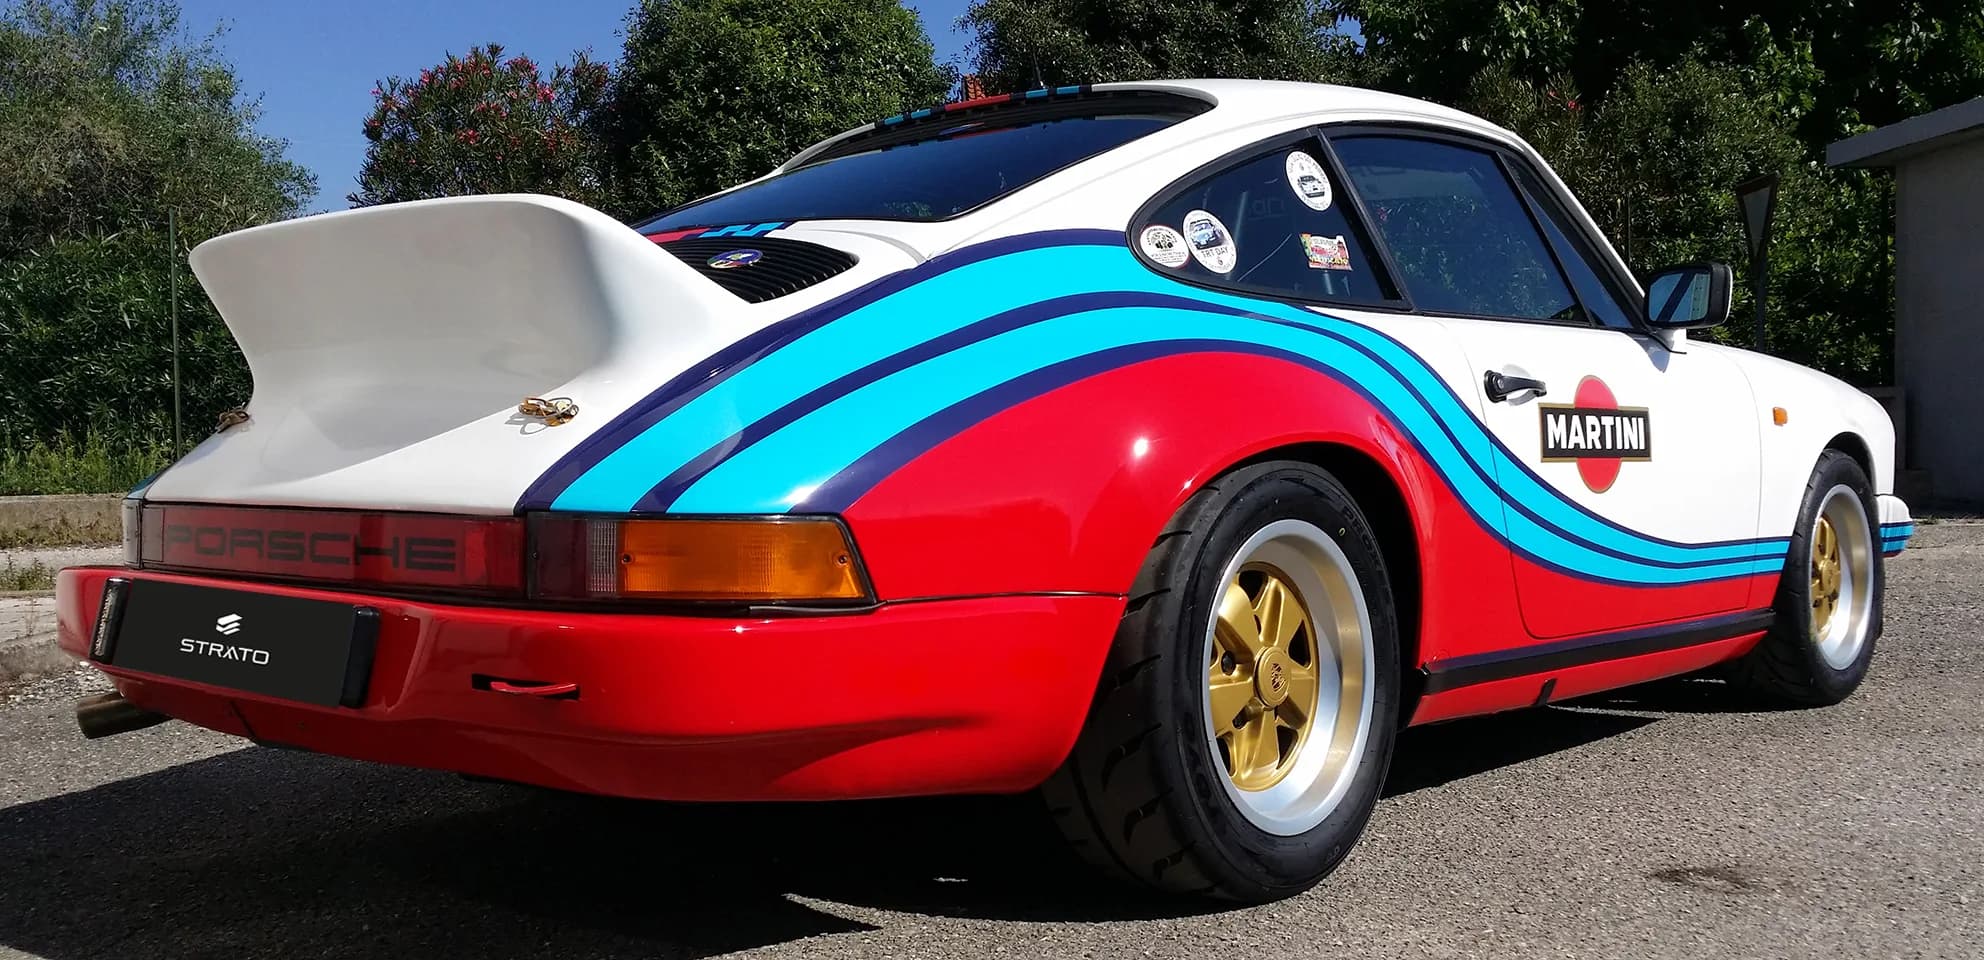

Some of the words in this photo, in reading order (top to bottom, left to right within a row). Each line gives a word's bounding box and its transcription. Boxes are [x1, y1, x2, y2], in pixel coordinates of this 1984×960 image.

[1215, 246, 1229, 256] DAY
[1546, 413, 1645, 450] MARTINI
[167, 524, 456, 572] PORSCHE
